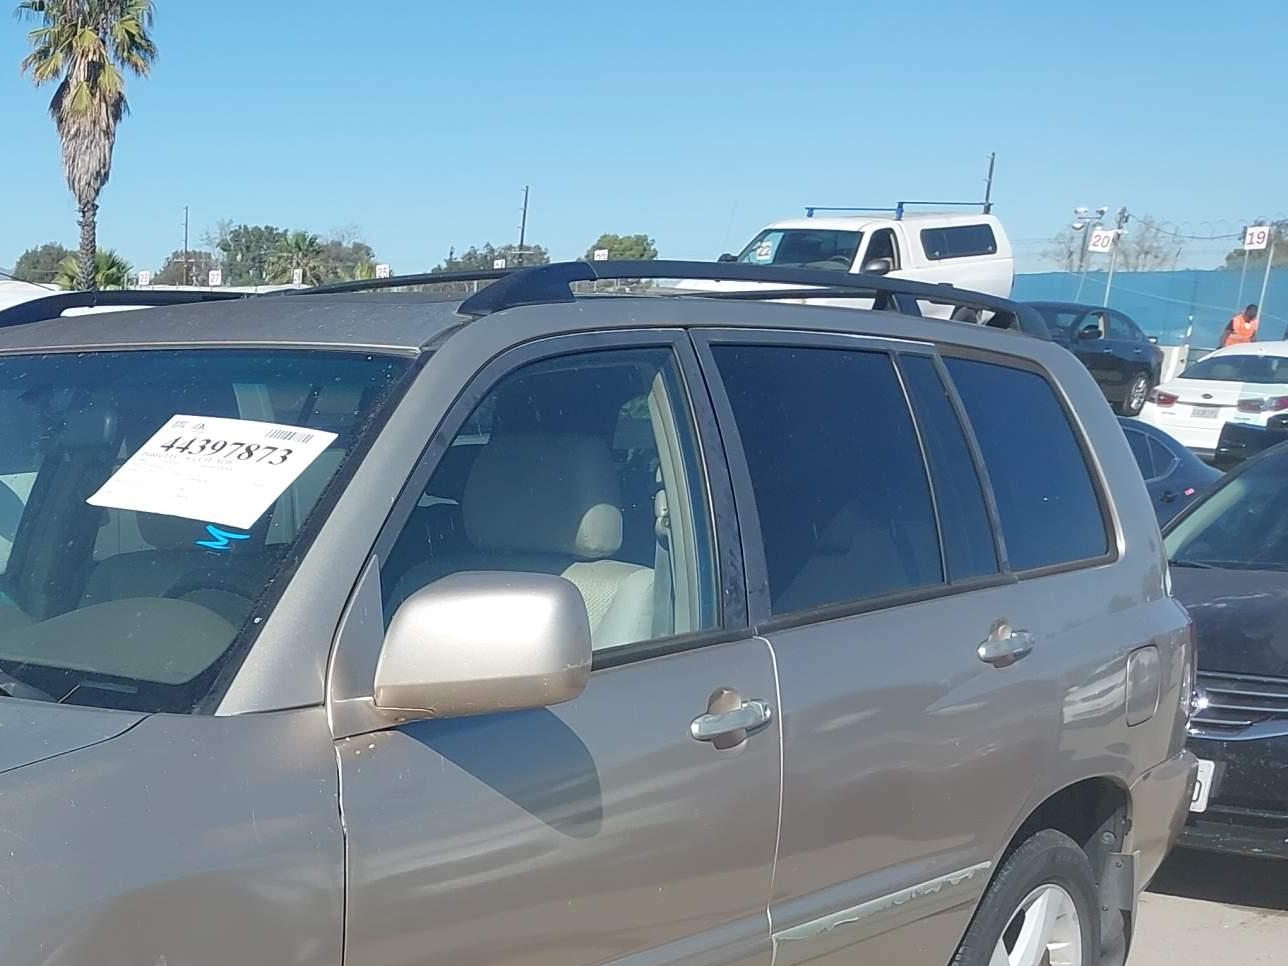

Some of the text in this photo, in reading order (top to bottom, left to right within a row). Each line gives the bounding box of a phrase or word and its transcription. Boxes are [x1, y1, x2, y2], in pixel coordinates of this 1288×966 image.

[1092, 234, 1110, 248] 20
[1246, 231, 1266, 245] 19
[160, 436, 293, 465] 44397873
